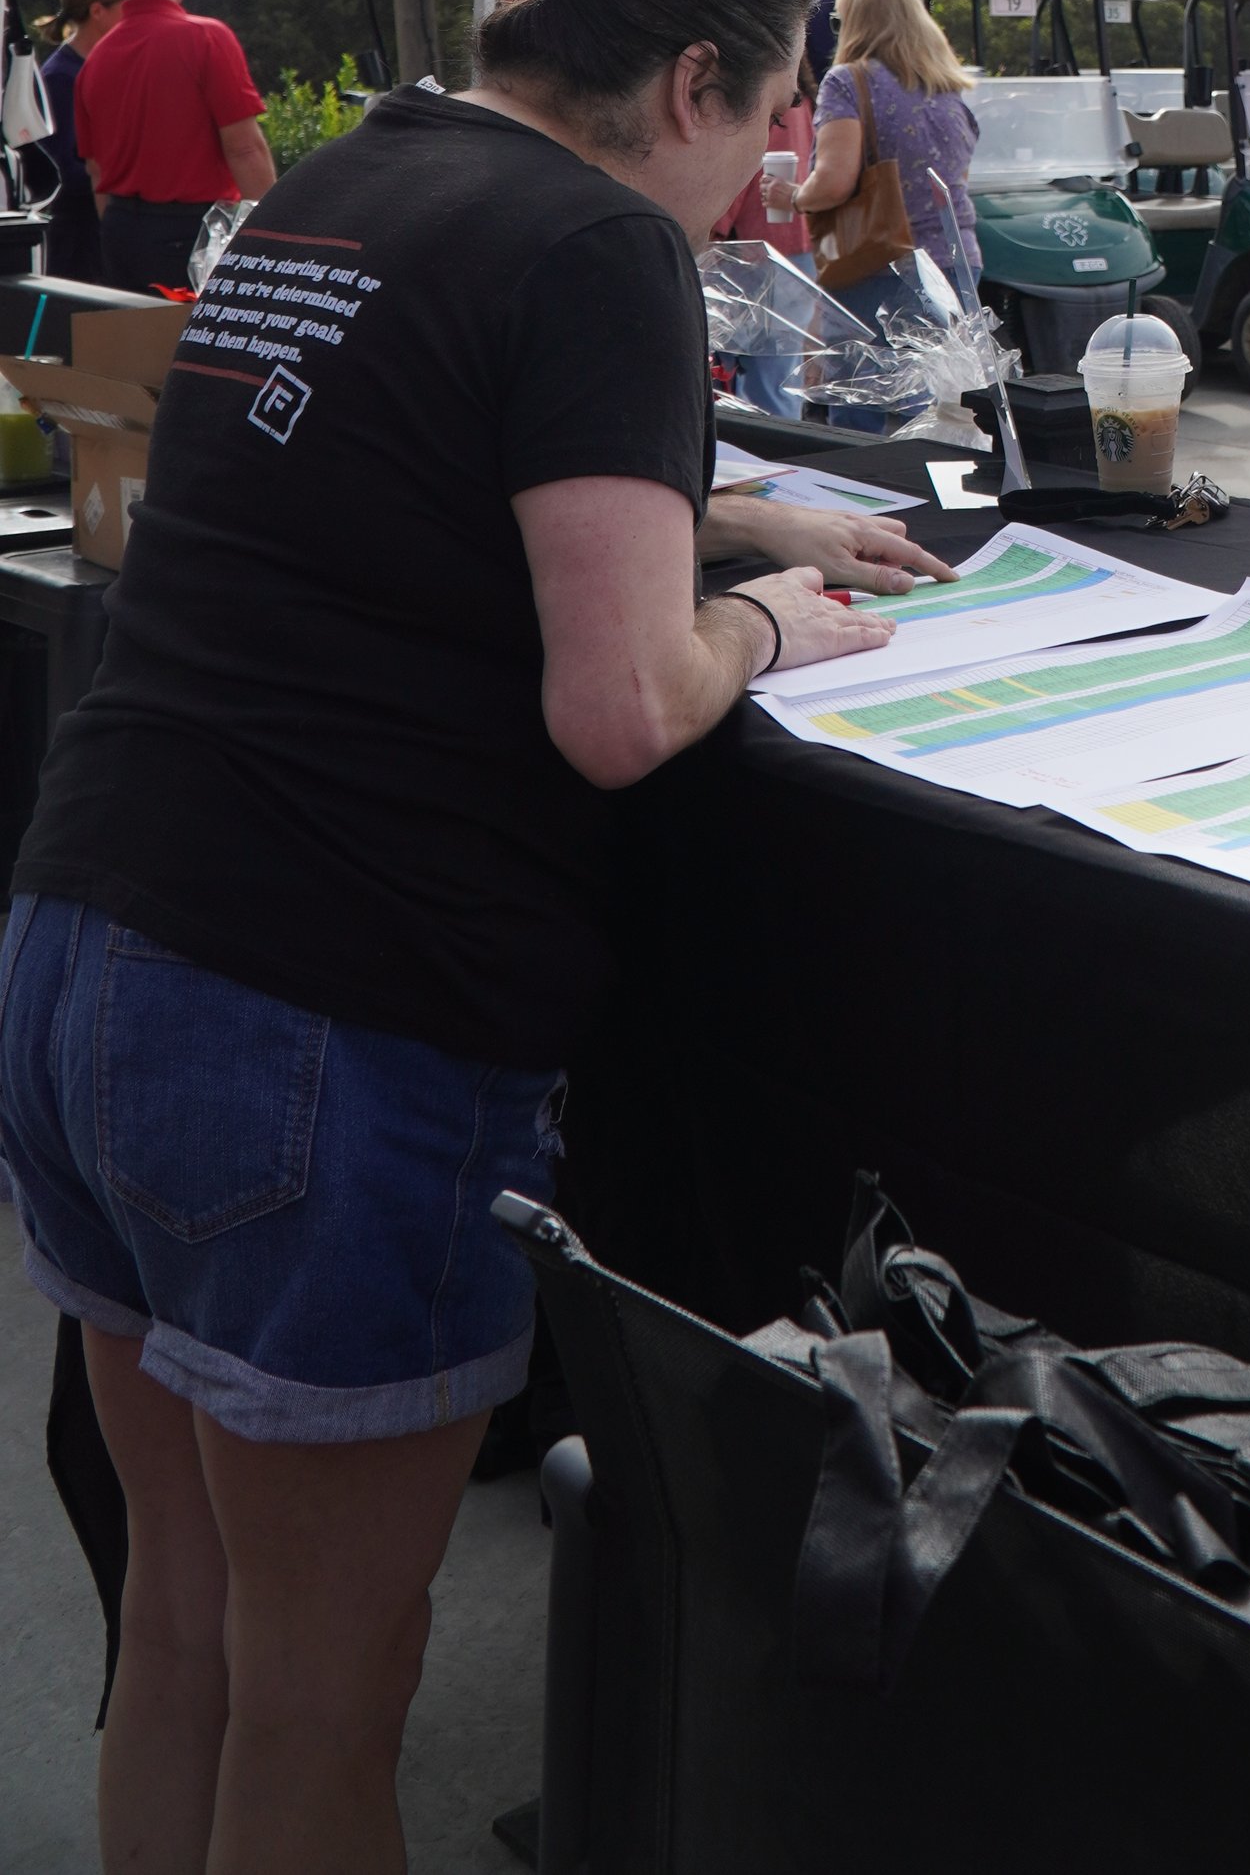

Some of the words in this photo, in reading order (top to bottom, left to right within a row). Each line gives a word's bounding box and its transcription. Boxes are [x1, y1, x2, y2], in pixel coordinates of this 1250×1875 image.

[235, 255, 275, 271] you're
[274, 259, 330, 281] starting
[329, 269, 358, 284] out
[358, 277, 381, 291] or
[237, 282, 273, 298] we're
[272, 285, 361, 317] determined
[217, 307, 264, 323] pursue
[261, 314, 297, 329] your
[295, 320, 344, 344] goals
[187, 328, 214, 344] make
[216, 331, 247, 349] them
[247, 336, 302, 362] happen.
